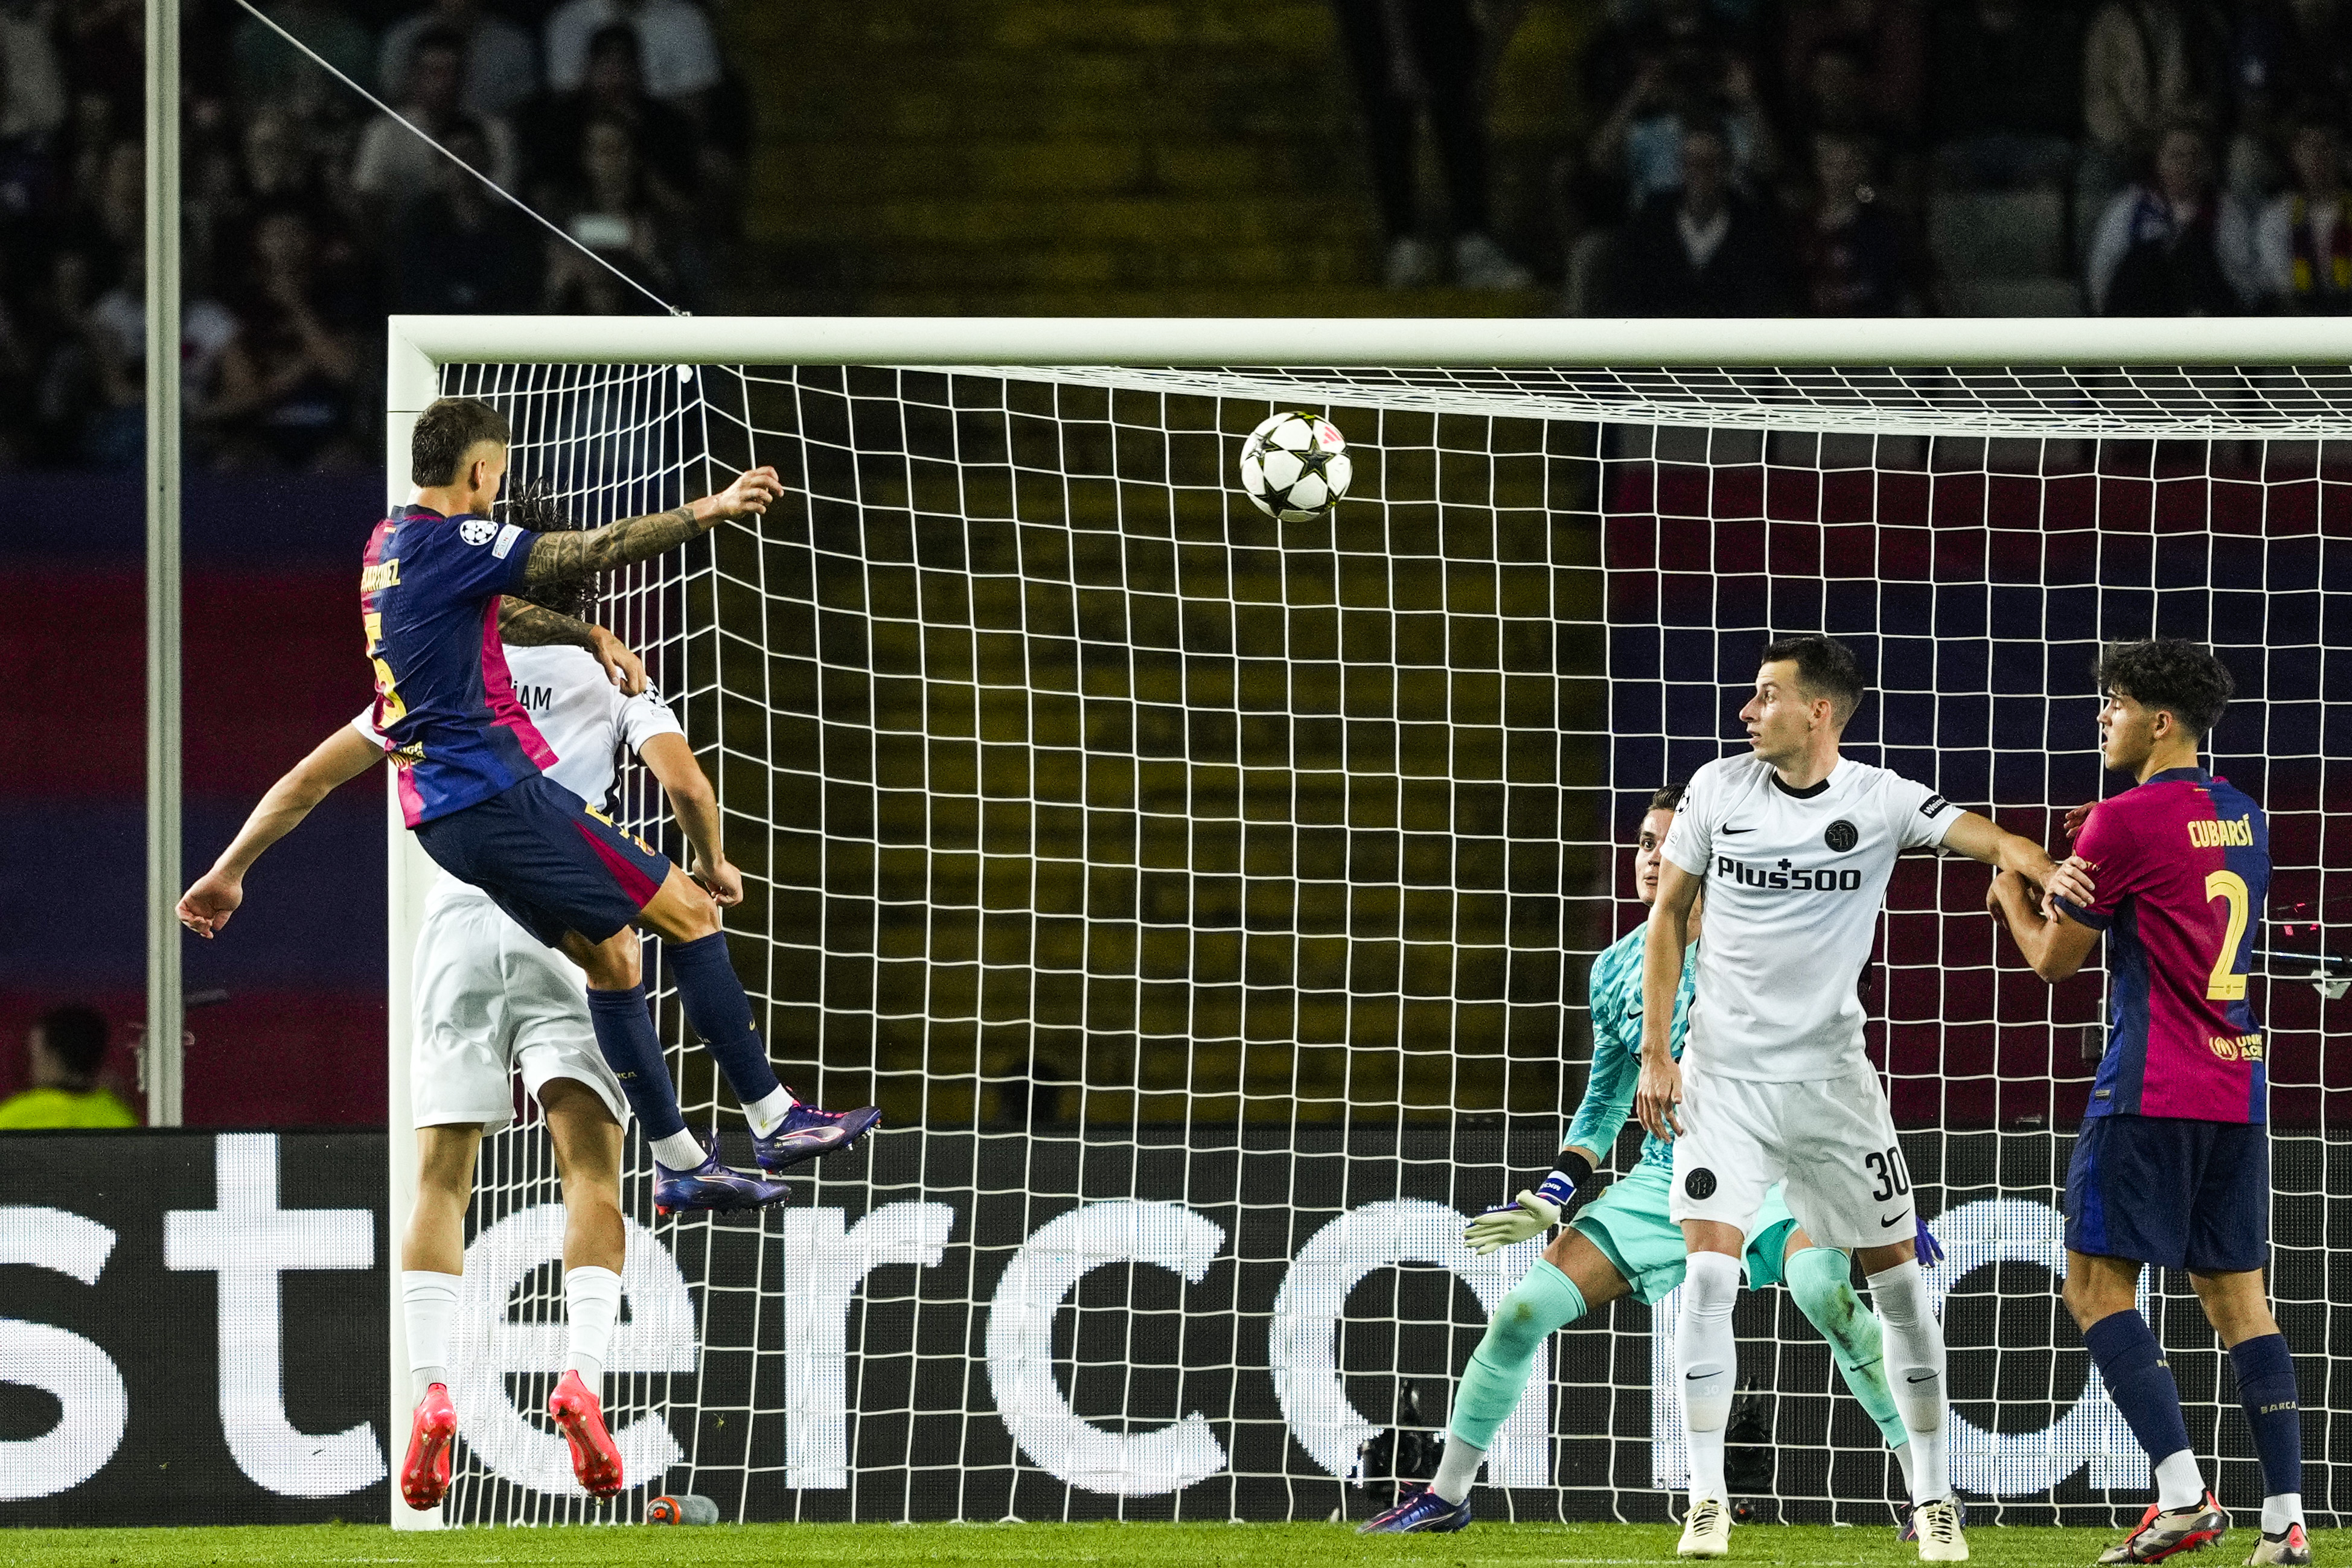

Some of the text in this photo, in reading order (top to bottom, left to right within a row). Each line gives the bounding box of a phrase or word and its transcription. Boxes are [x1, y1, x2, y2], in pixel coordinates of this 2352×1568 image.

[2187, 813, 2254, 847] CUBARSÍ
[2205, 870, 2249, 1001] 2
[1865, 1147, 1909, 1202] 30
